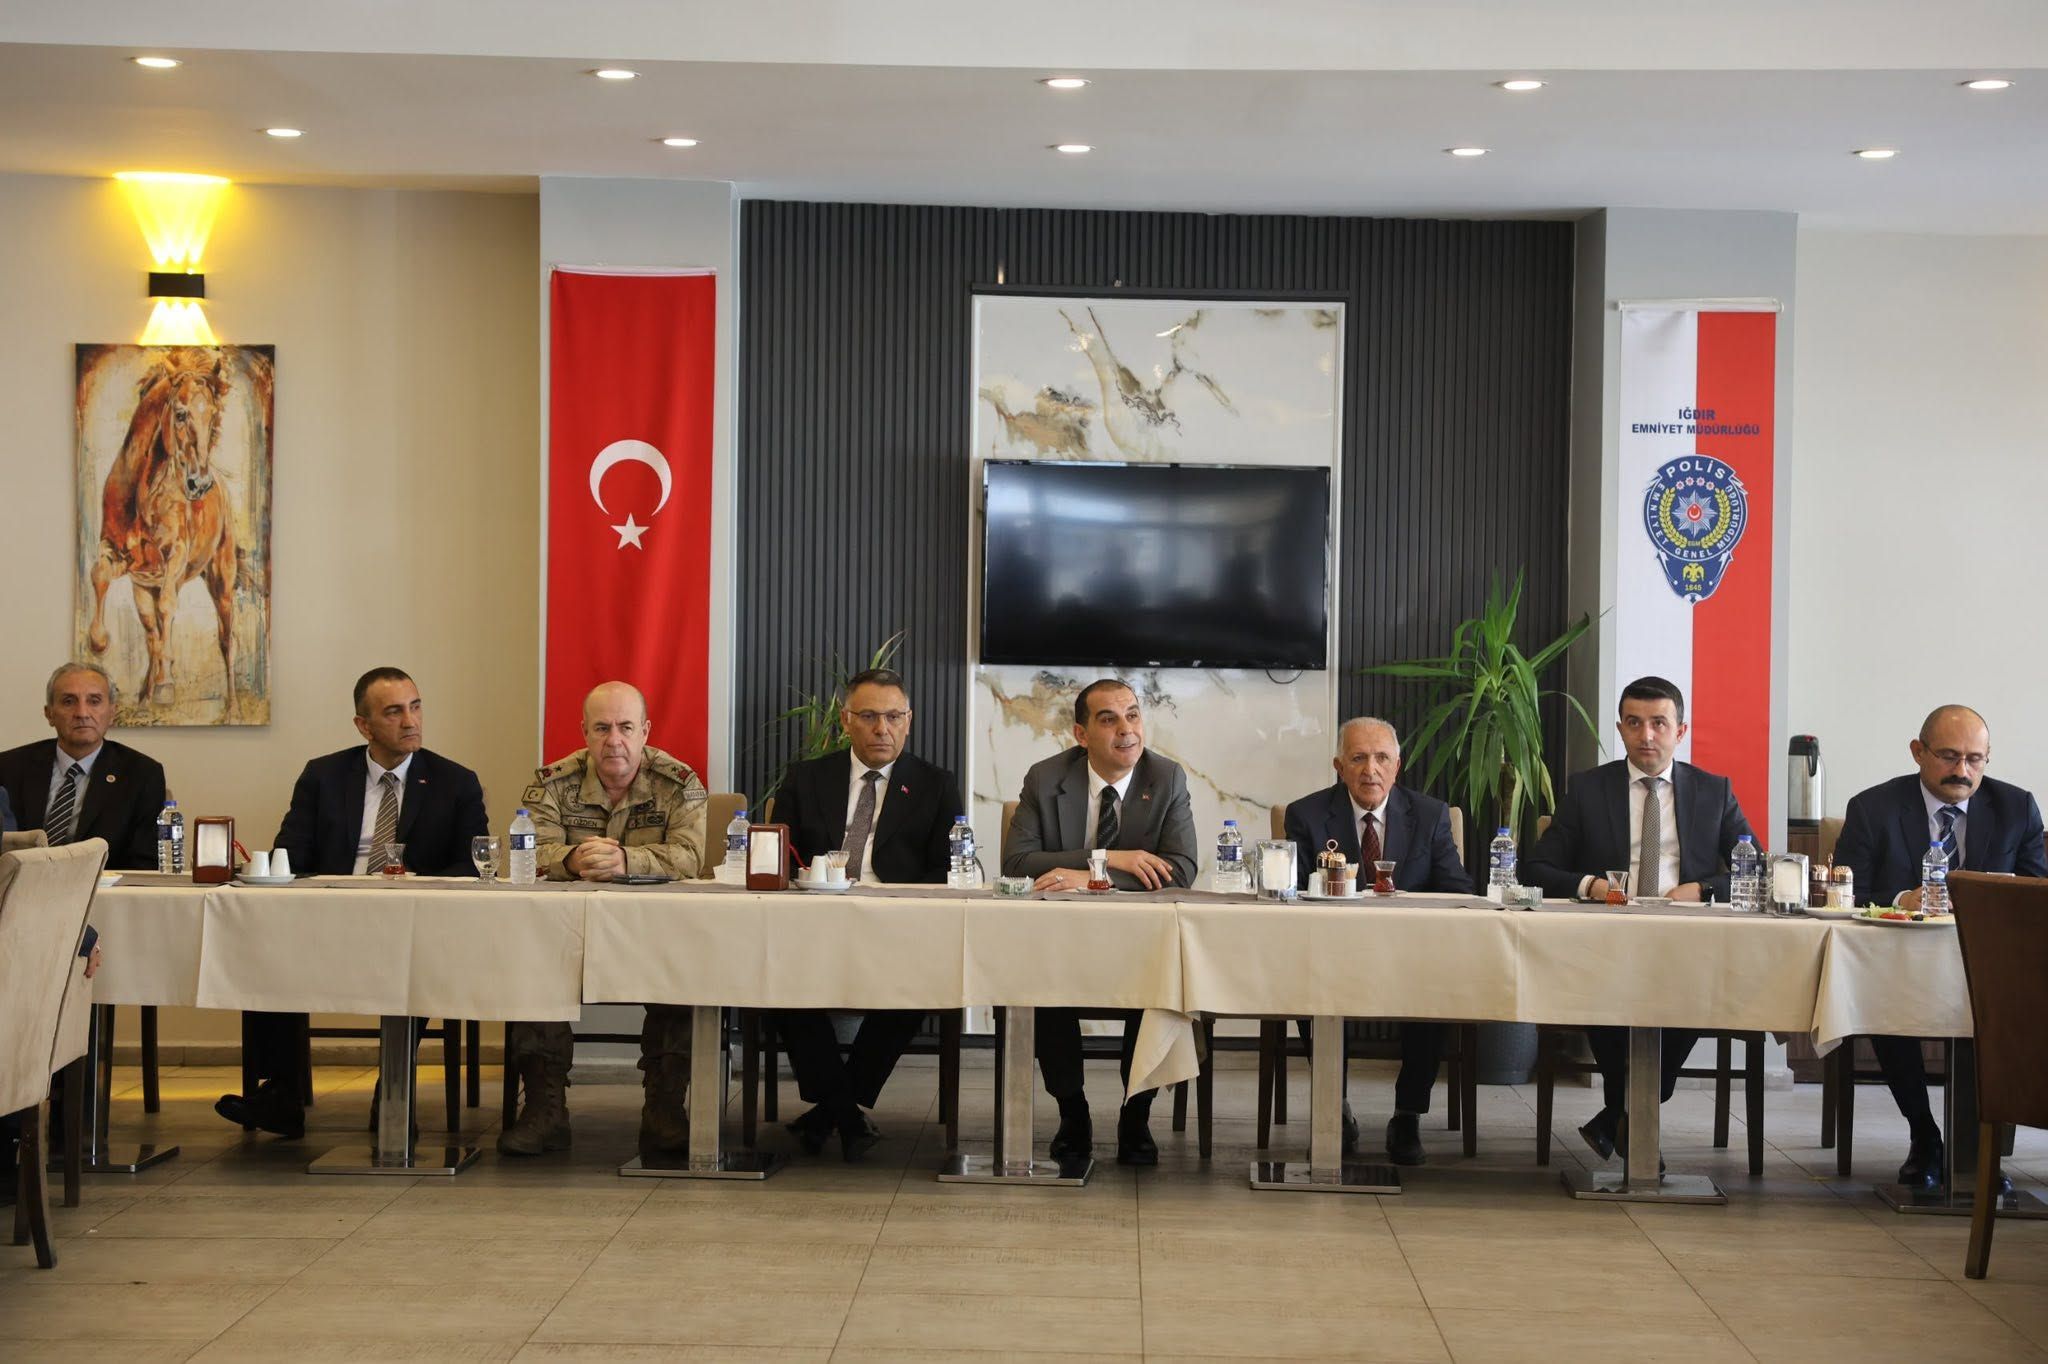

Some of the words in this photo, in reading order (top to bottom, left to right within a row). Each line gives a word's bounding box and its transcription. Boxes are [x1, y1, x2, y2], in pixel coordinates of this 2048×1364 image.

[1678, 406, 1716, 420] IĞDIR
[1632, 422, 1683, 434] EMNİYET
[1666, 459, 1726, 479] POLİS
[1675, 547, 1713, 558] GENEL
